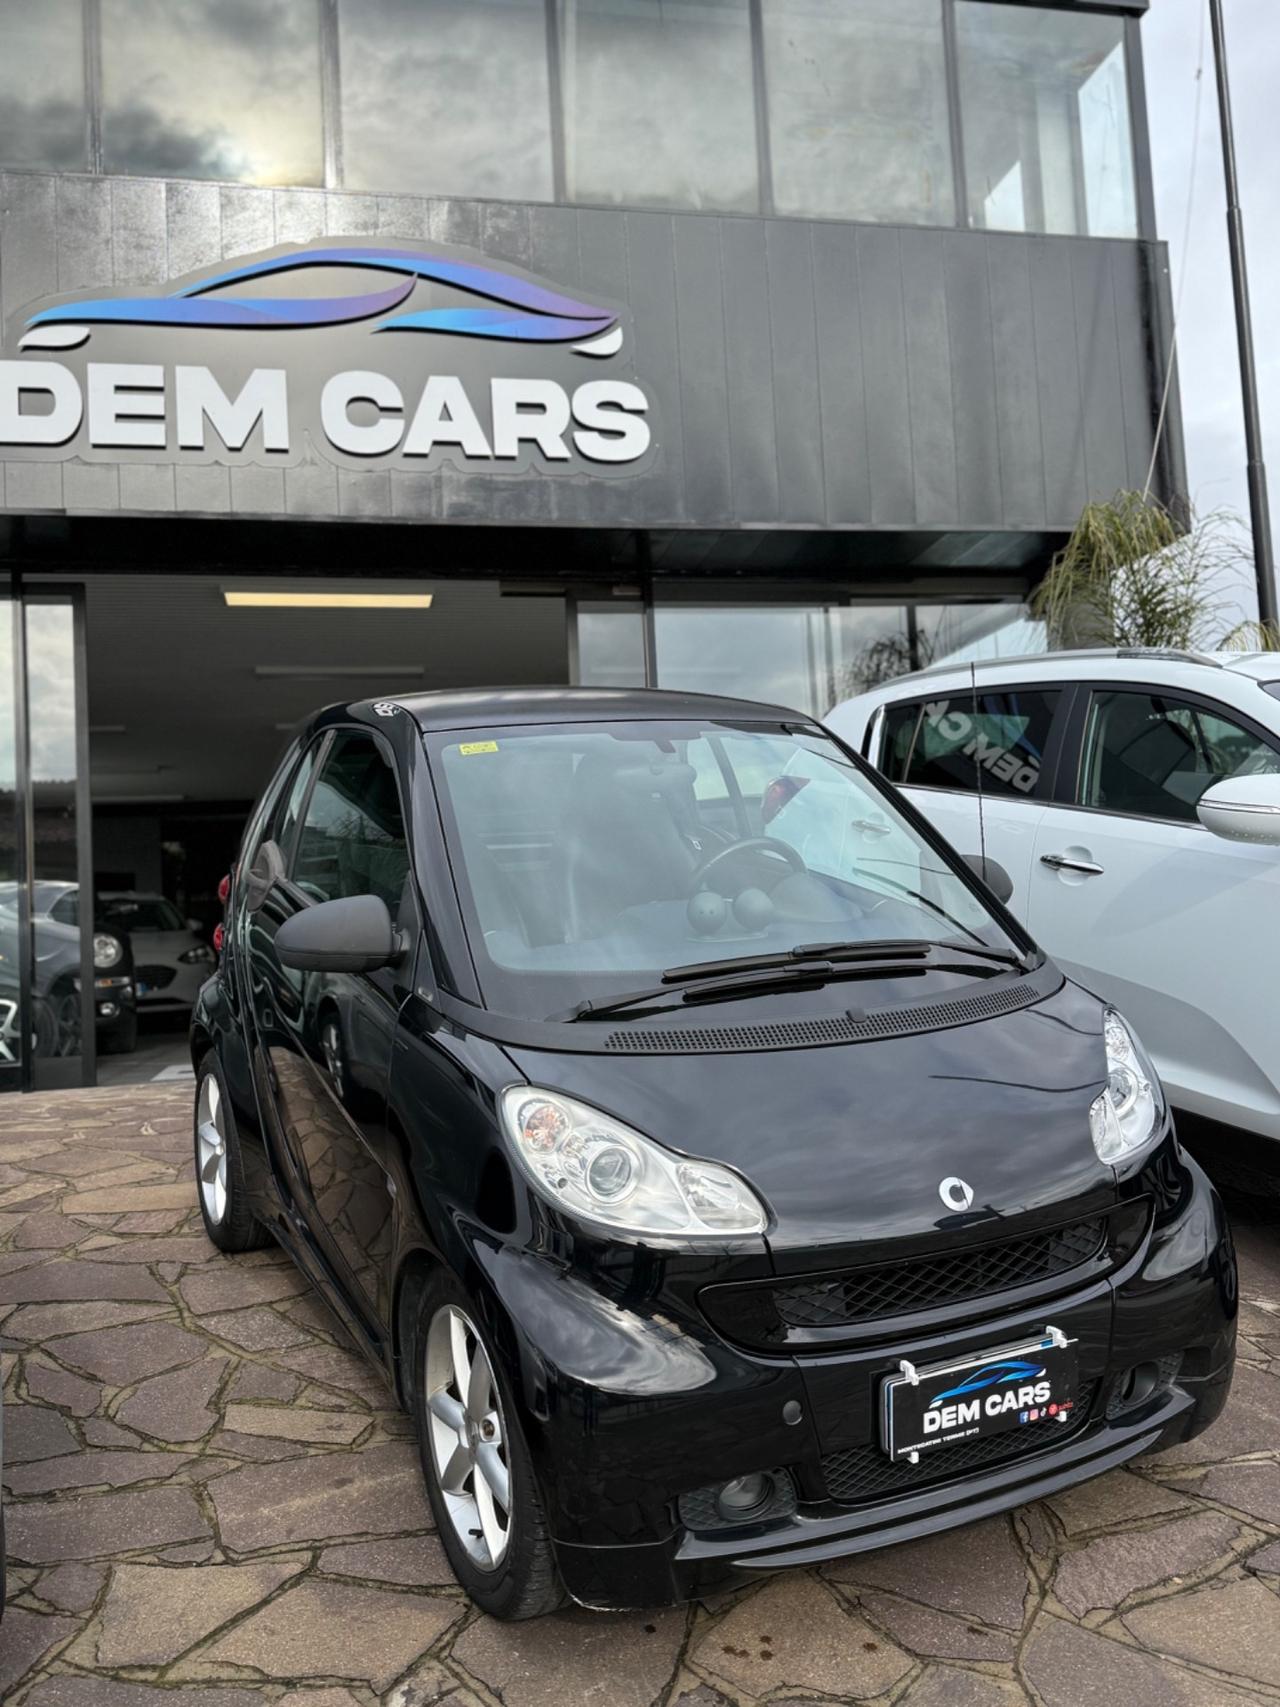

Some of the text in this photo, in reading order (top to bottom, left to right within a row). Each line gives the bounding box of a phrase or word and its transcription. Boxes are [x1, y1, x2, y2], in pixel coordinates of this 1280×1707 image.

[0, 360, 651, 462] DEM CARS
[923, 1381, 1051, 1434] DEM CARS
